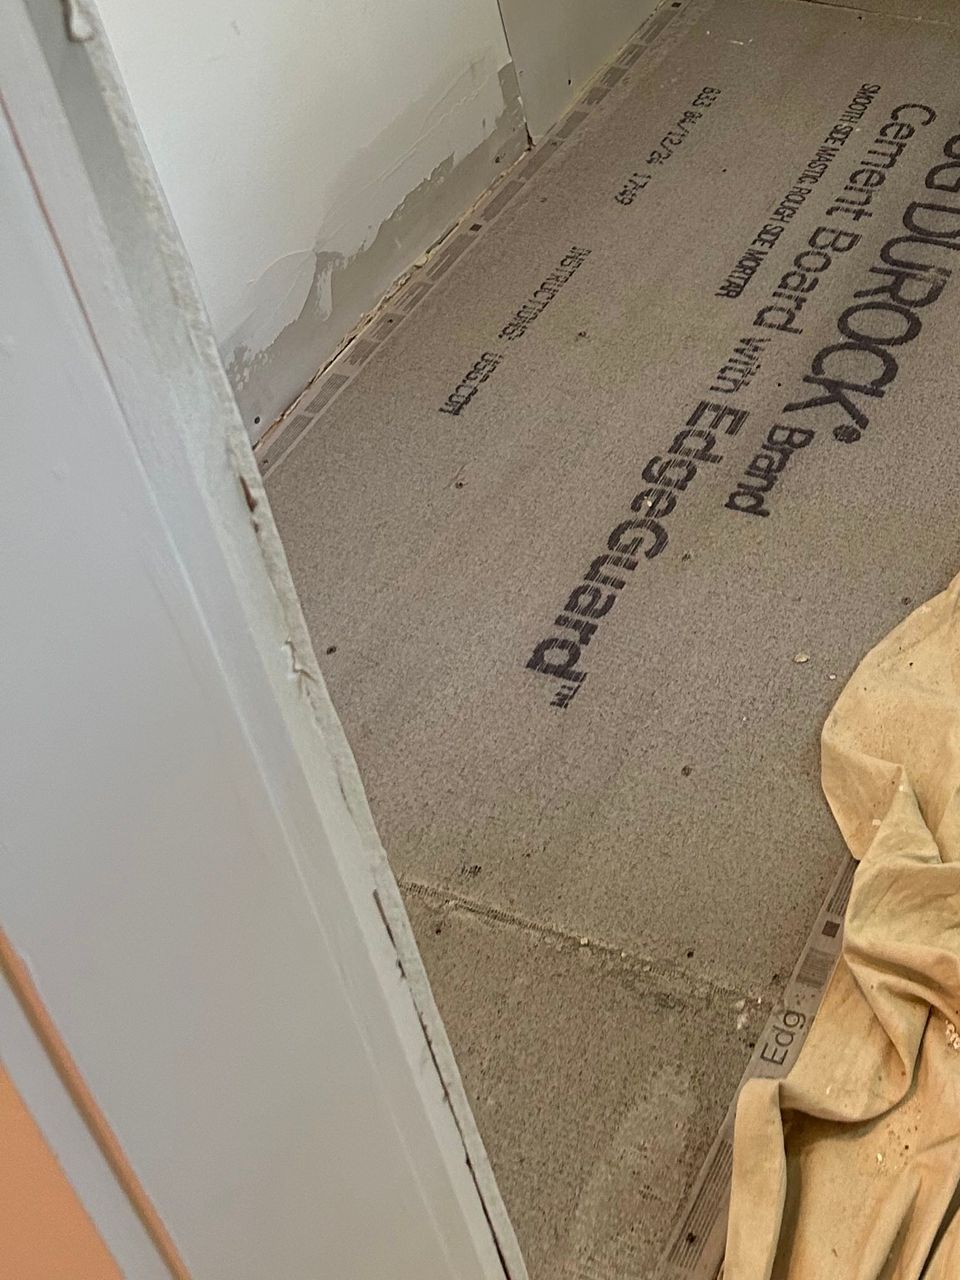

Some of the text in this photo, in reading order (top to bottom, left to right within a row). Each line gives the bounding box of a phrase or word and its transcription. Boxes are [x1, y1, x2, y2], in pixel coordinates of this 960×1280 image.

[692, 86, 721, 107] 633
[840, 83, 881, 124] SMOOTH
[824, 123, 853, 146] SIDE
[826, 102, 937, 221] Cement
[770, 186, 812, 223] ROUGH
[751, 223, 784, 249] SIDE
[714, 248, 769, 299] MORTAR
[753, 226, 863, 334] Board
[710, 335, 772, 394] with
[725, 423, 815, 518] Brand
